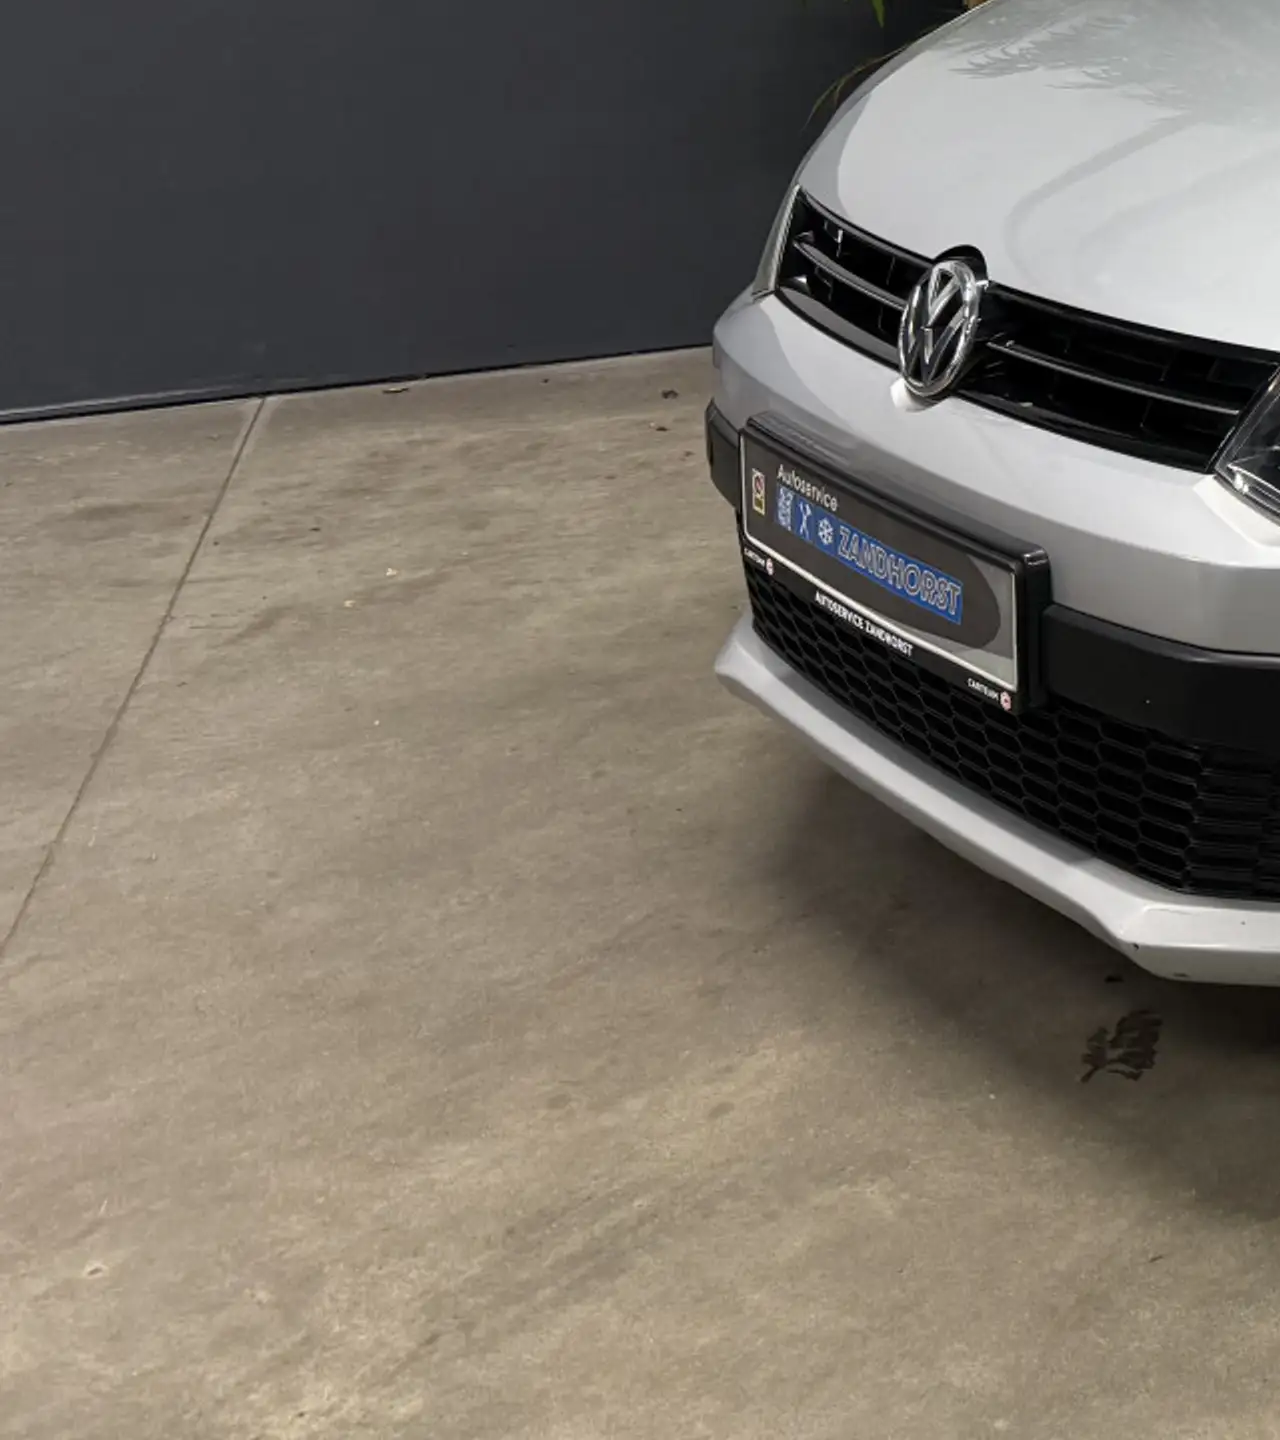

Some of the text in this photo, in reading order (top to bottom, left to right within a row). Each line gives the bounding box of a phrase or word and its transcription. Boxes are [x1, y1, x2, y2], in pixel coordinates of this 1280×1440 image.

[776, 463, 838, 512] Autoservice
[838, 525, 961, 615] ZANDHORST
[814, 590, 864, 631] AUTOSERVICE
